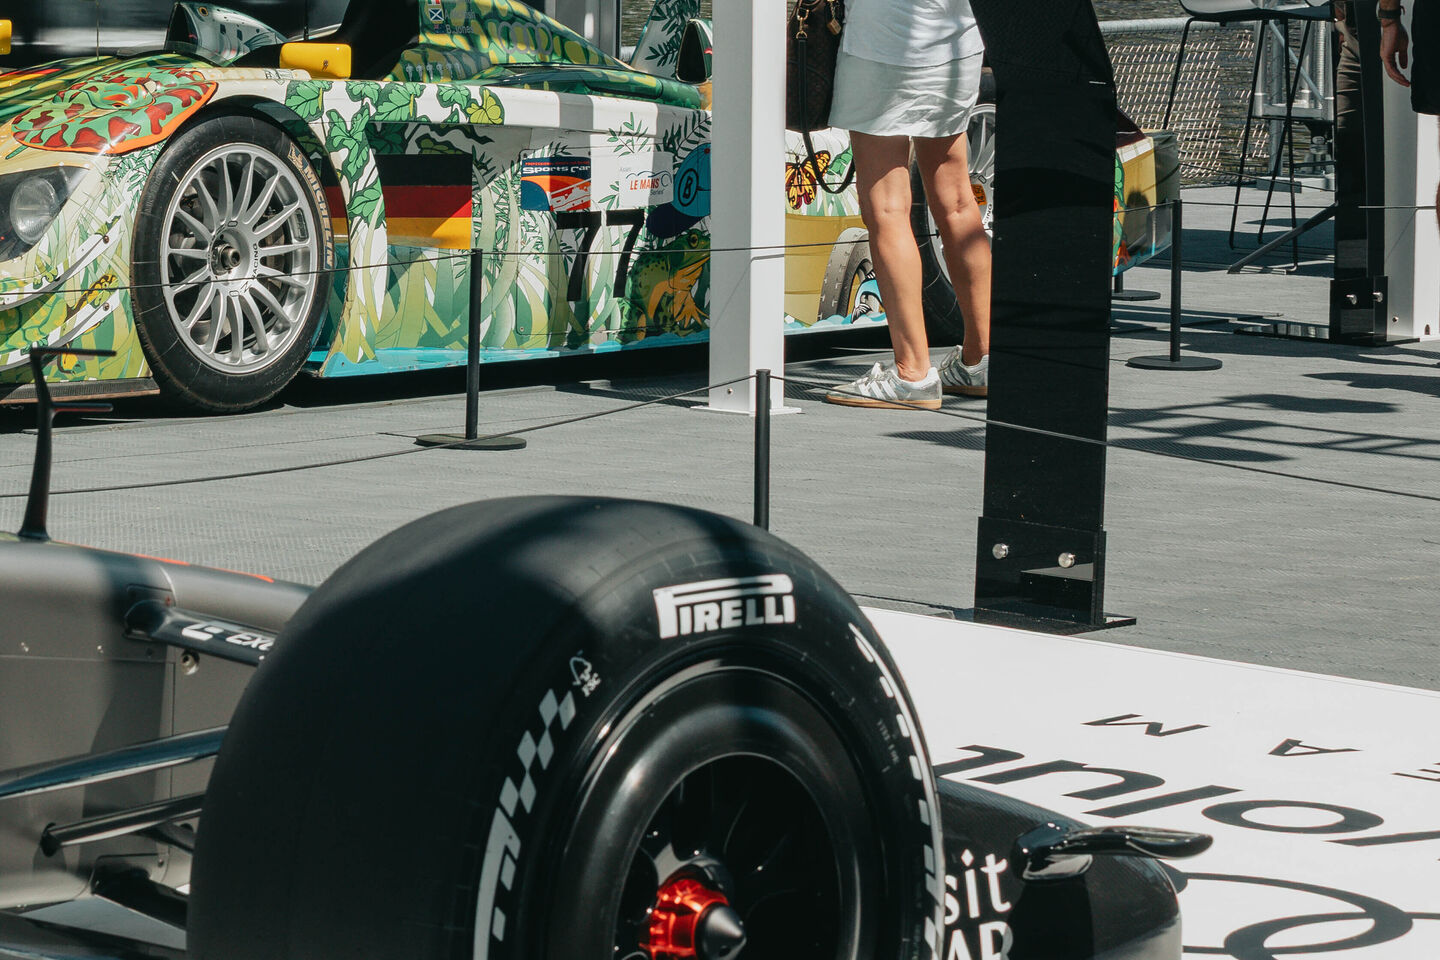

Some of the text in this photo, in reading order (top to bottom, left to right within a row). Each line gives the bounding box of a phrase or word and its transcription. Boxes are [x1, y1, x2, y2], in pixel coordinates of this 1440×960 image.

[522, 166, 569, 174] Sports
[629, 178, 660, 190] LE MANS
[556, 208, 645, 302] 77
[652, 573, 796, 640] PIRELLI
[944, 848, 1012, 926] sit
